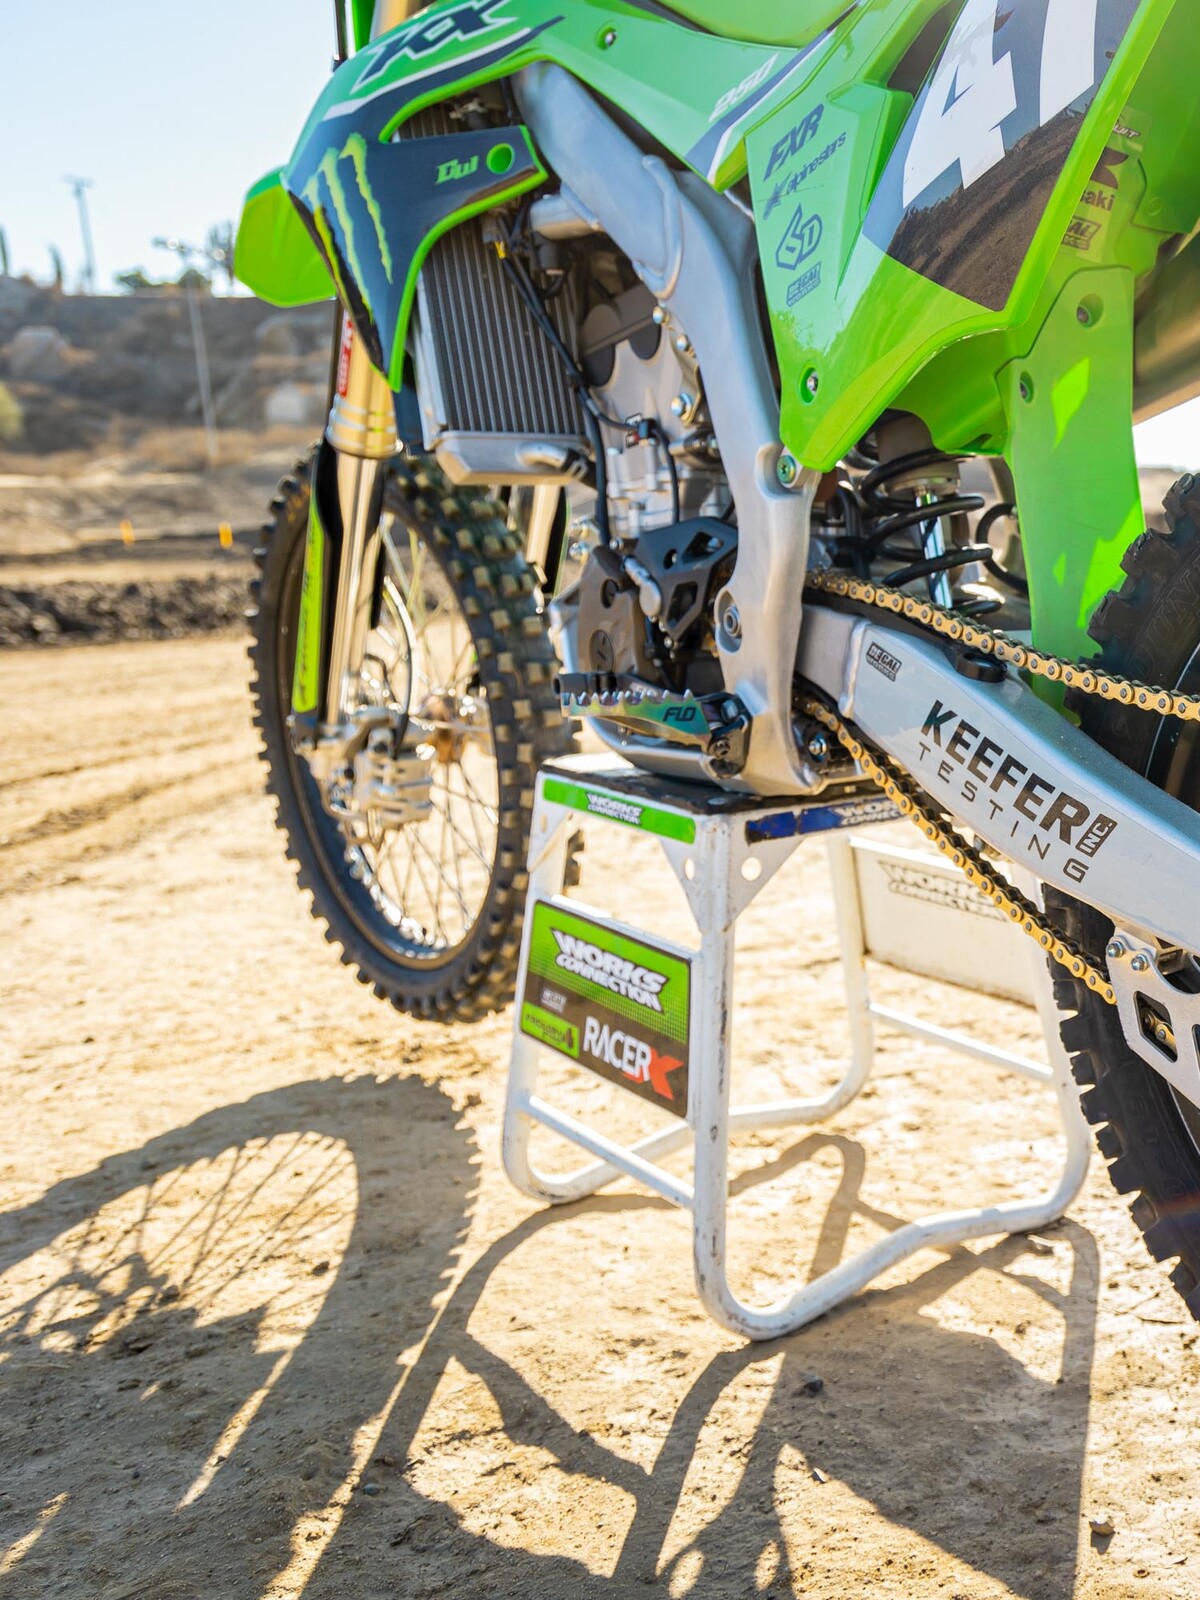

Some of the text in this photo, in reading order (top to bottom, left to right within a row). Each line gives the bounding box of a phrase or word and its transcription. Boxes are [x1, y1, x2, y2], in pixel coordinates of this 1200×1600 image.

[763, 103, 825, 182] FXR
[786, 131, 847, 196] alpinestars
[661, 706, 697, 723] FLO
[920, 700, 1091, 846] KEEFER
[586, 792, 644, 817] WORKS
[587, 804, 642, 826] CONNECTION
[831, 800, 900, 818] WOR
[840, 809, 901, 826] CONNEC
[918, 741, 1090, 883] TESTING
[552, 928, 670, 994] WORKS
[555, 952, 665, 1014] CONNECTION
